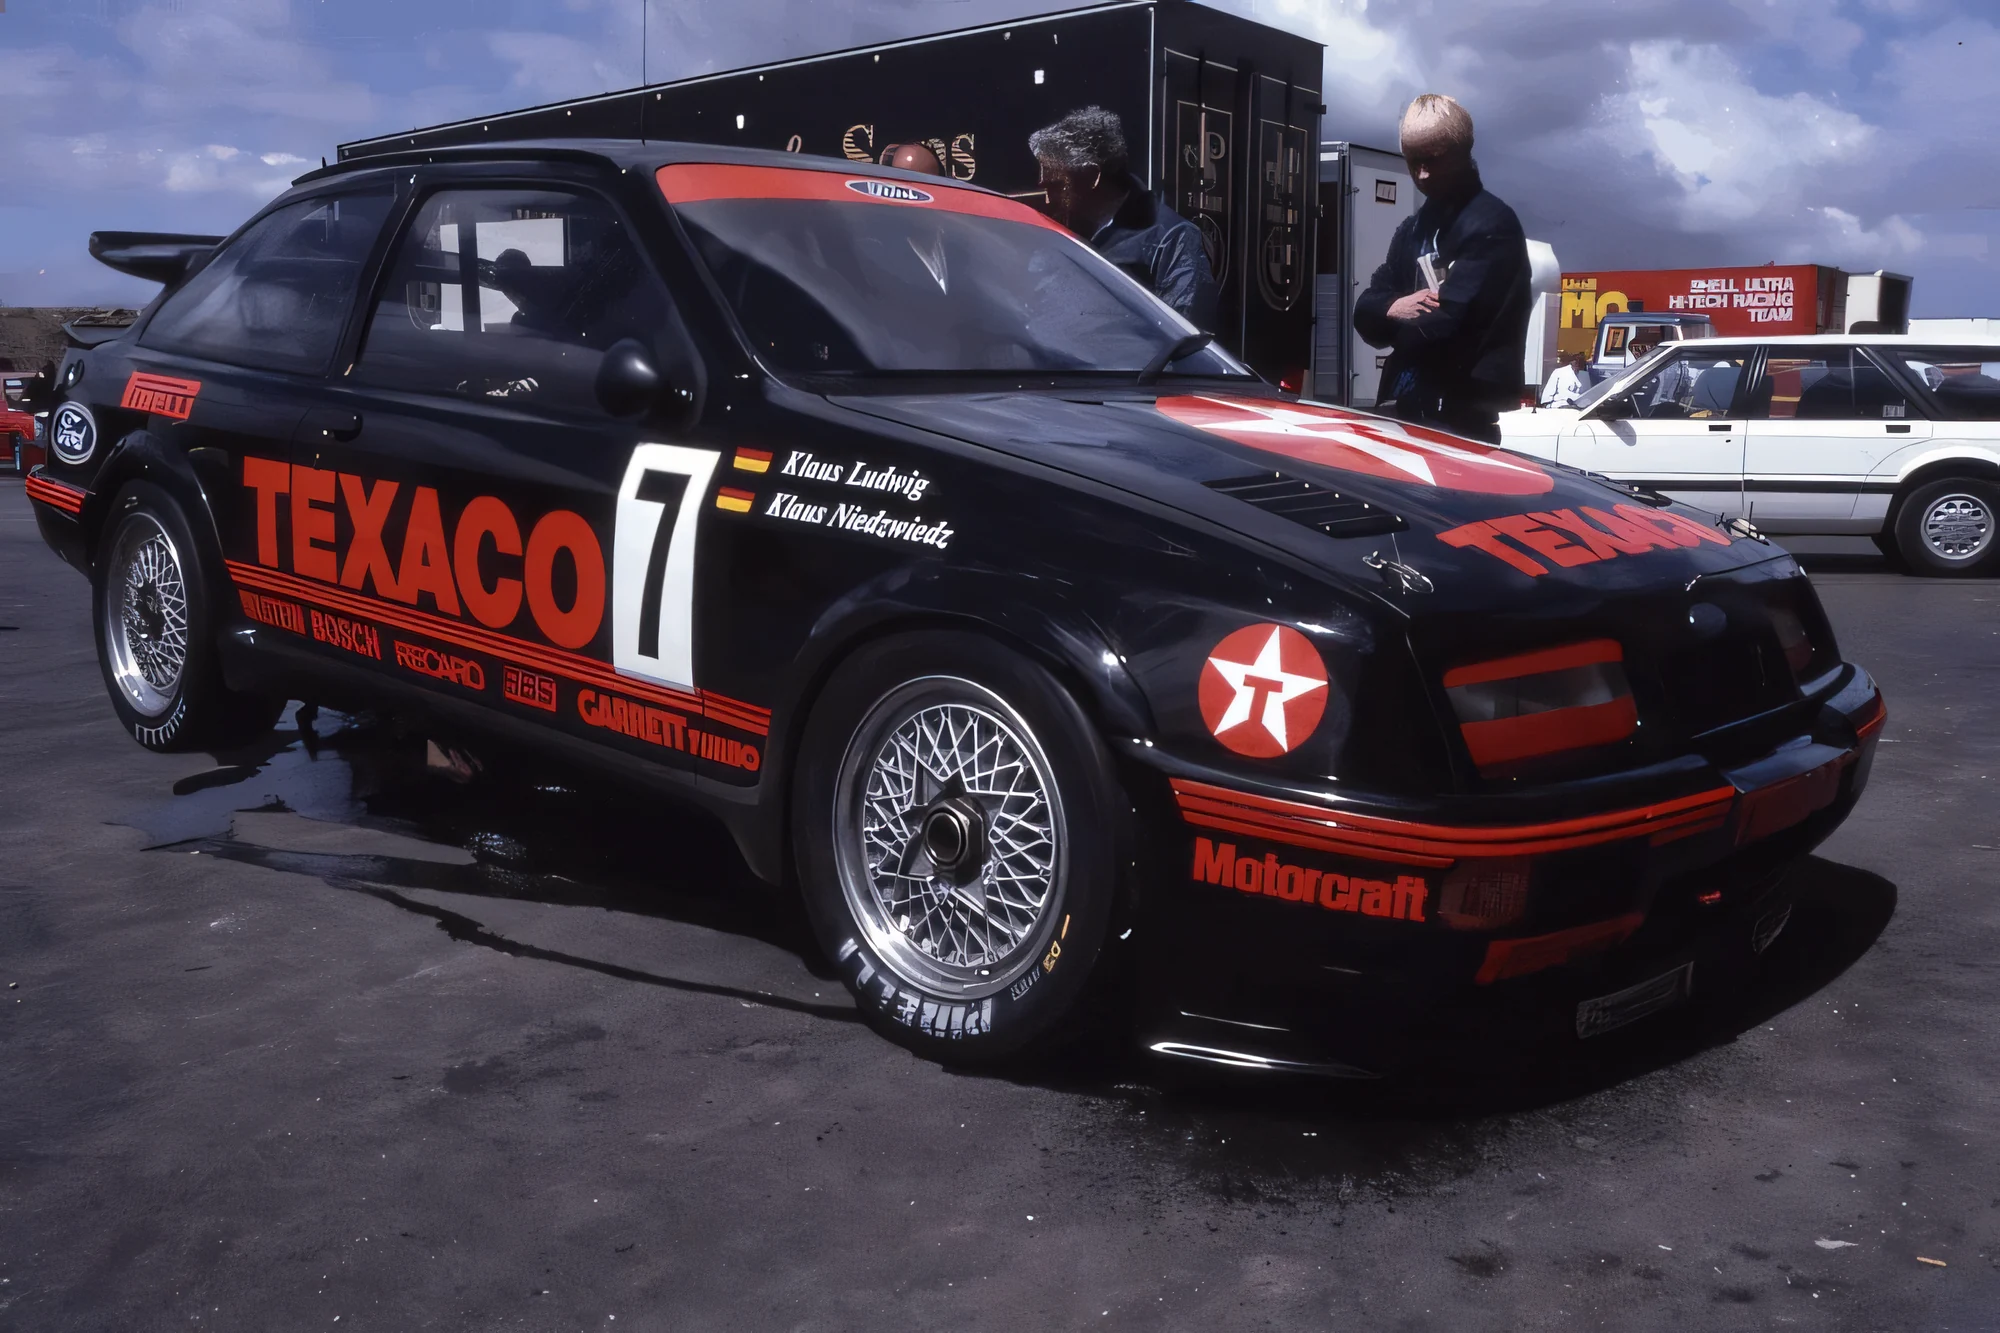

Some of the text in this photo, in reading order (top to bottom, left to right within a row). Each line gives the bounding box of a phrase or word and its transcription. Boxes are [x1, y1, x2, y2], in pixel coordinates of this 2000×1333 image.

[1744, 276, 1794, 292] ULTRA
[1747, 307, 1793, 322] TEAM
[781, 450, 930, 501] Klaus Ludwig
[764, 492, 955, 549] Klaus Niedzwiedz
[1435, 503, 1732, 577] TEXACO
[243, 455, 606, 650] TEXACO
[310, 608, 382, 661] BOSCH
[393, 639, 486, 691] RECARO
[577, 688, 687, 752] GARRETT
[1193, 837, 1428, 922] Motorcraft
